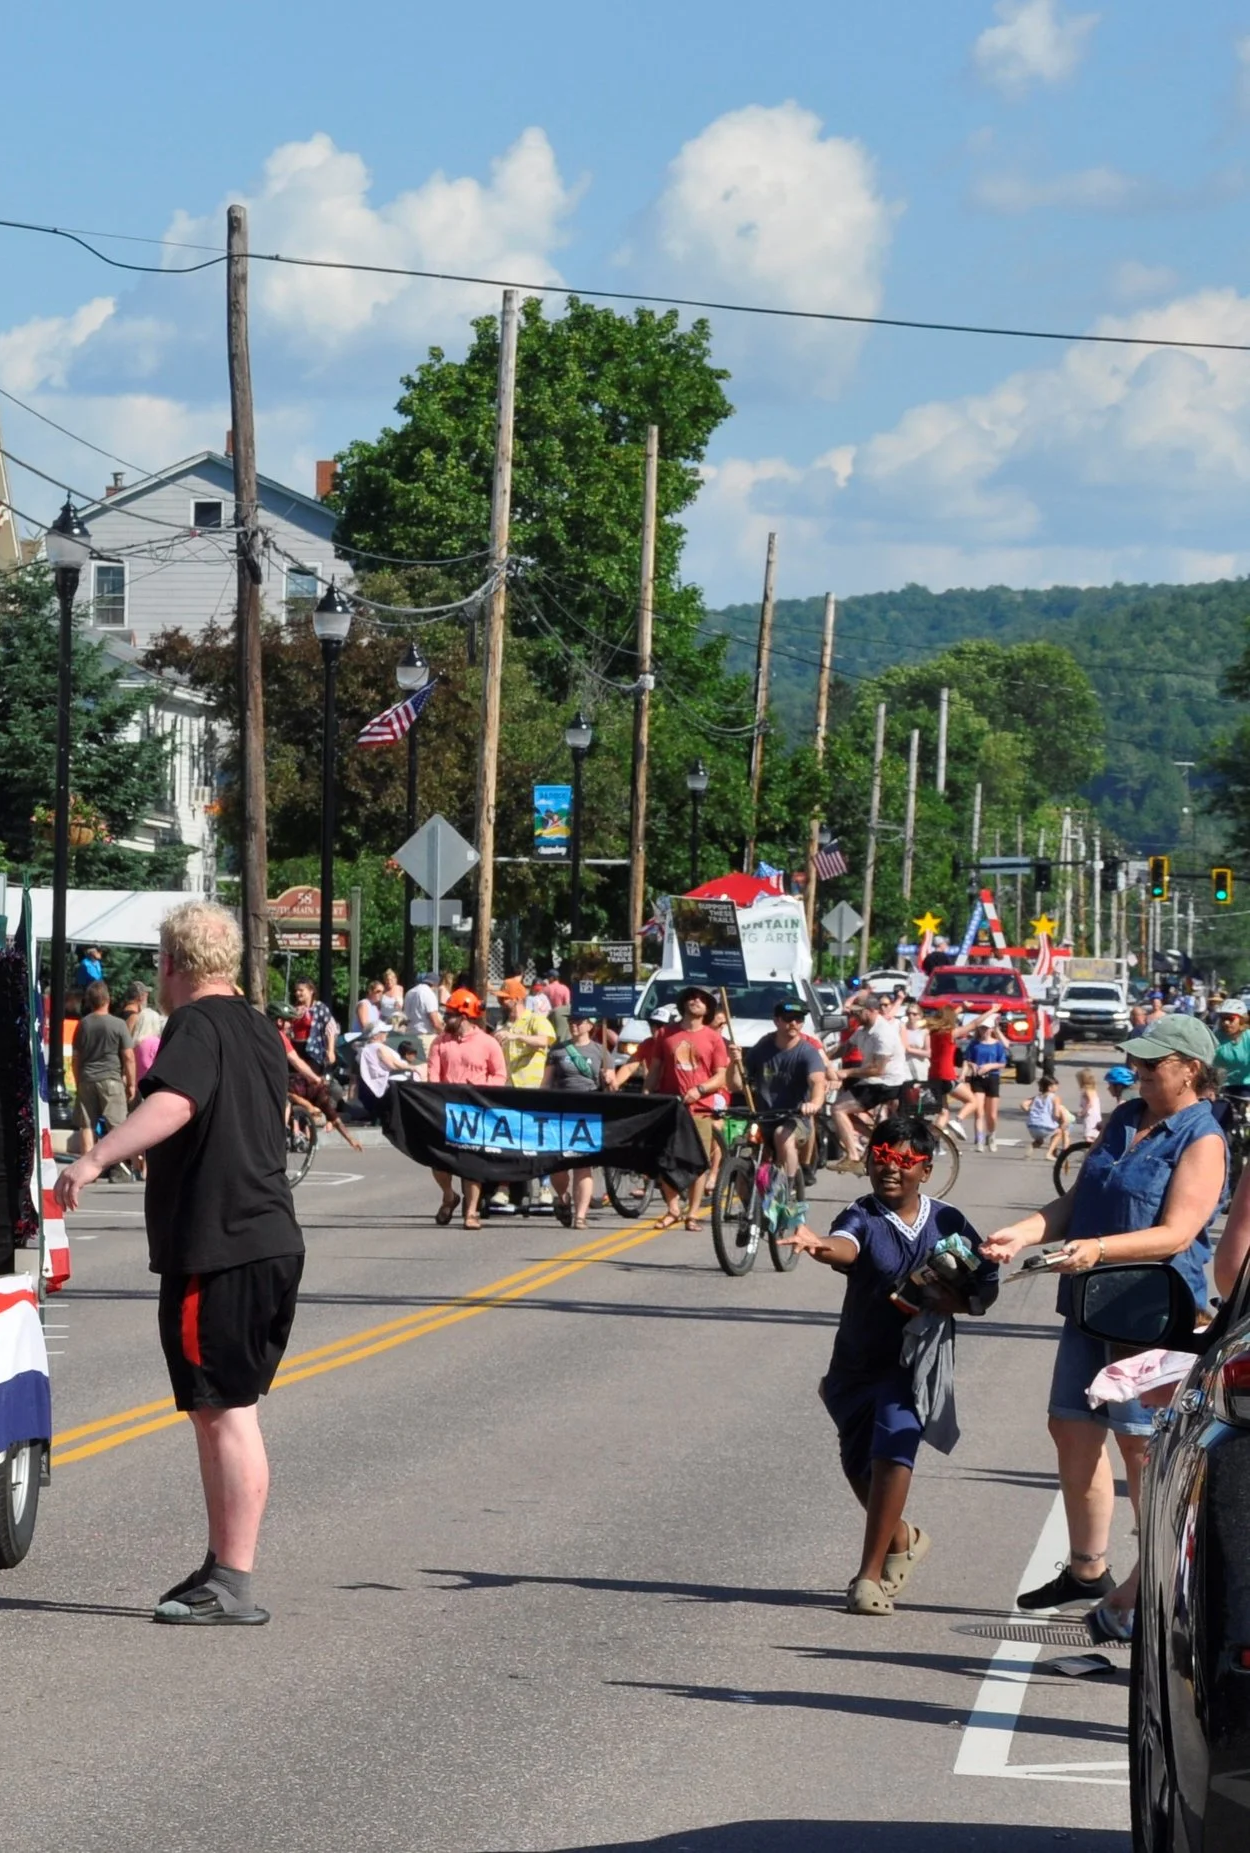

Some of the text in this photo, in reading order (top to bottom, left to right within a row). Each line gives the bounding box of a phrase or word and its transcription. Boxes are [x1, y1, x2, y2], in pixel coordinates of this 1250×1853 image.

[297, 892, 312, 905] 58
[698, 903, 732, 912] SUPPORT
[709, 909, 734, 918] THESE
[708, 916, 735, 924] TRAILS
[764, 932, 799, 944] ARTS
[599, 945, 633, 953] SUPPORT
[450, 1109, 597, 1149] WATA
